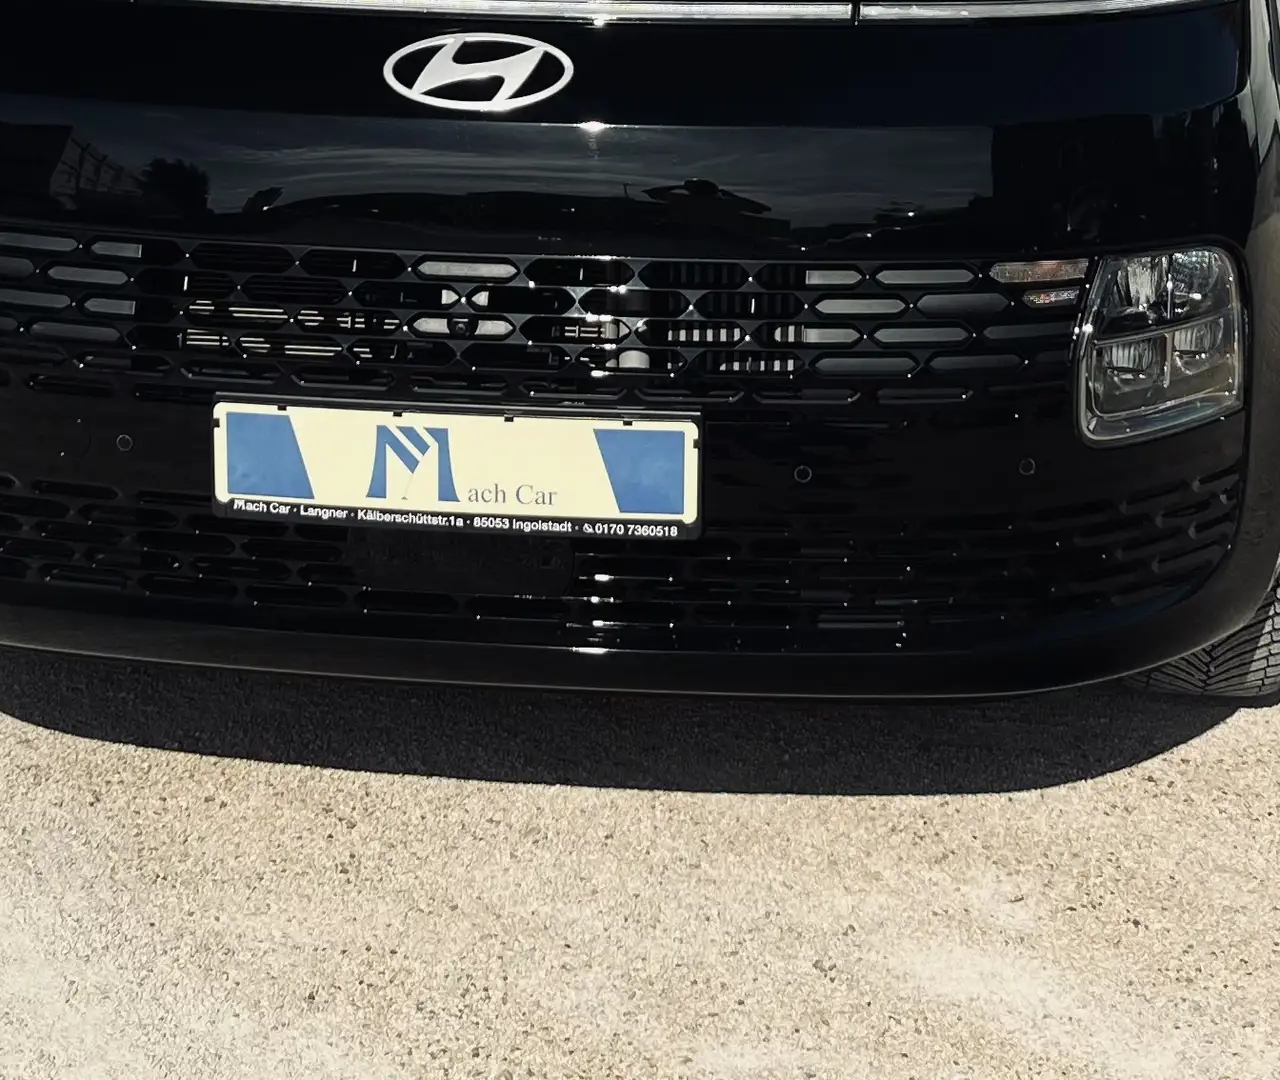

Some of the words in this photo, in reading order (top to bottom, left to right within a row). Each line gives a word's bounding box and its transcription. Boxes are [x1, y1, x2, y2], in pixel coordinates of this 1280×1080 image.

[515, 483, 558, 505] Car
[233, 498, 267, 512] Mach
[270, 502, 291, 514] Car
[300, 504, 348, 519] Langner
[473, 517, 510, 529] 85053
[512, 519, 572, 532] Ingolstadt
[595, 523, 624, 535] 0170
[627, 524, 678, 536] 7360518
